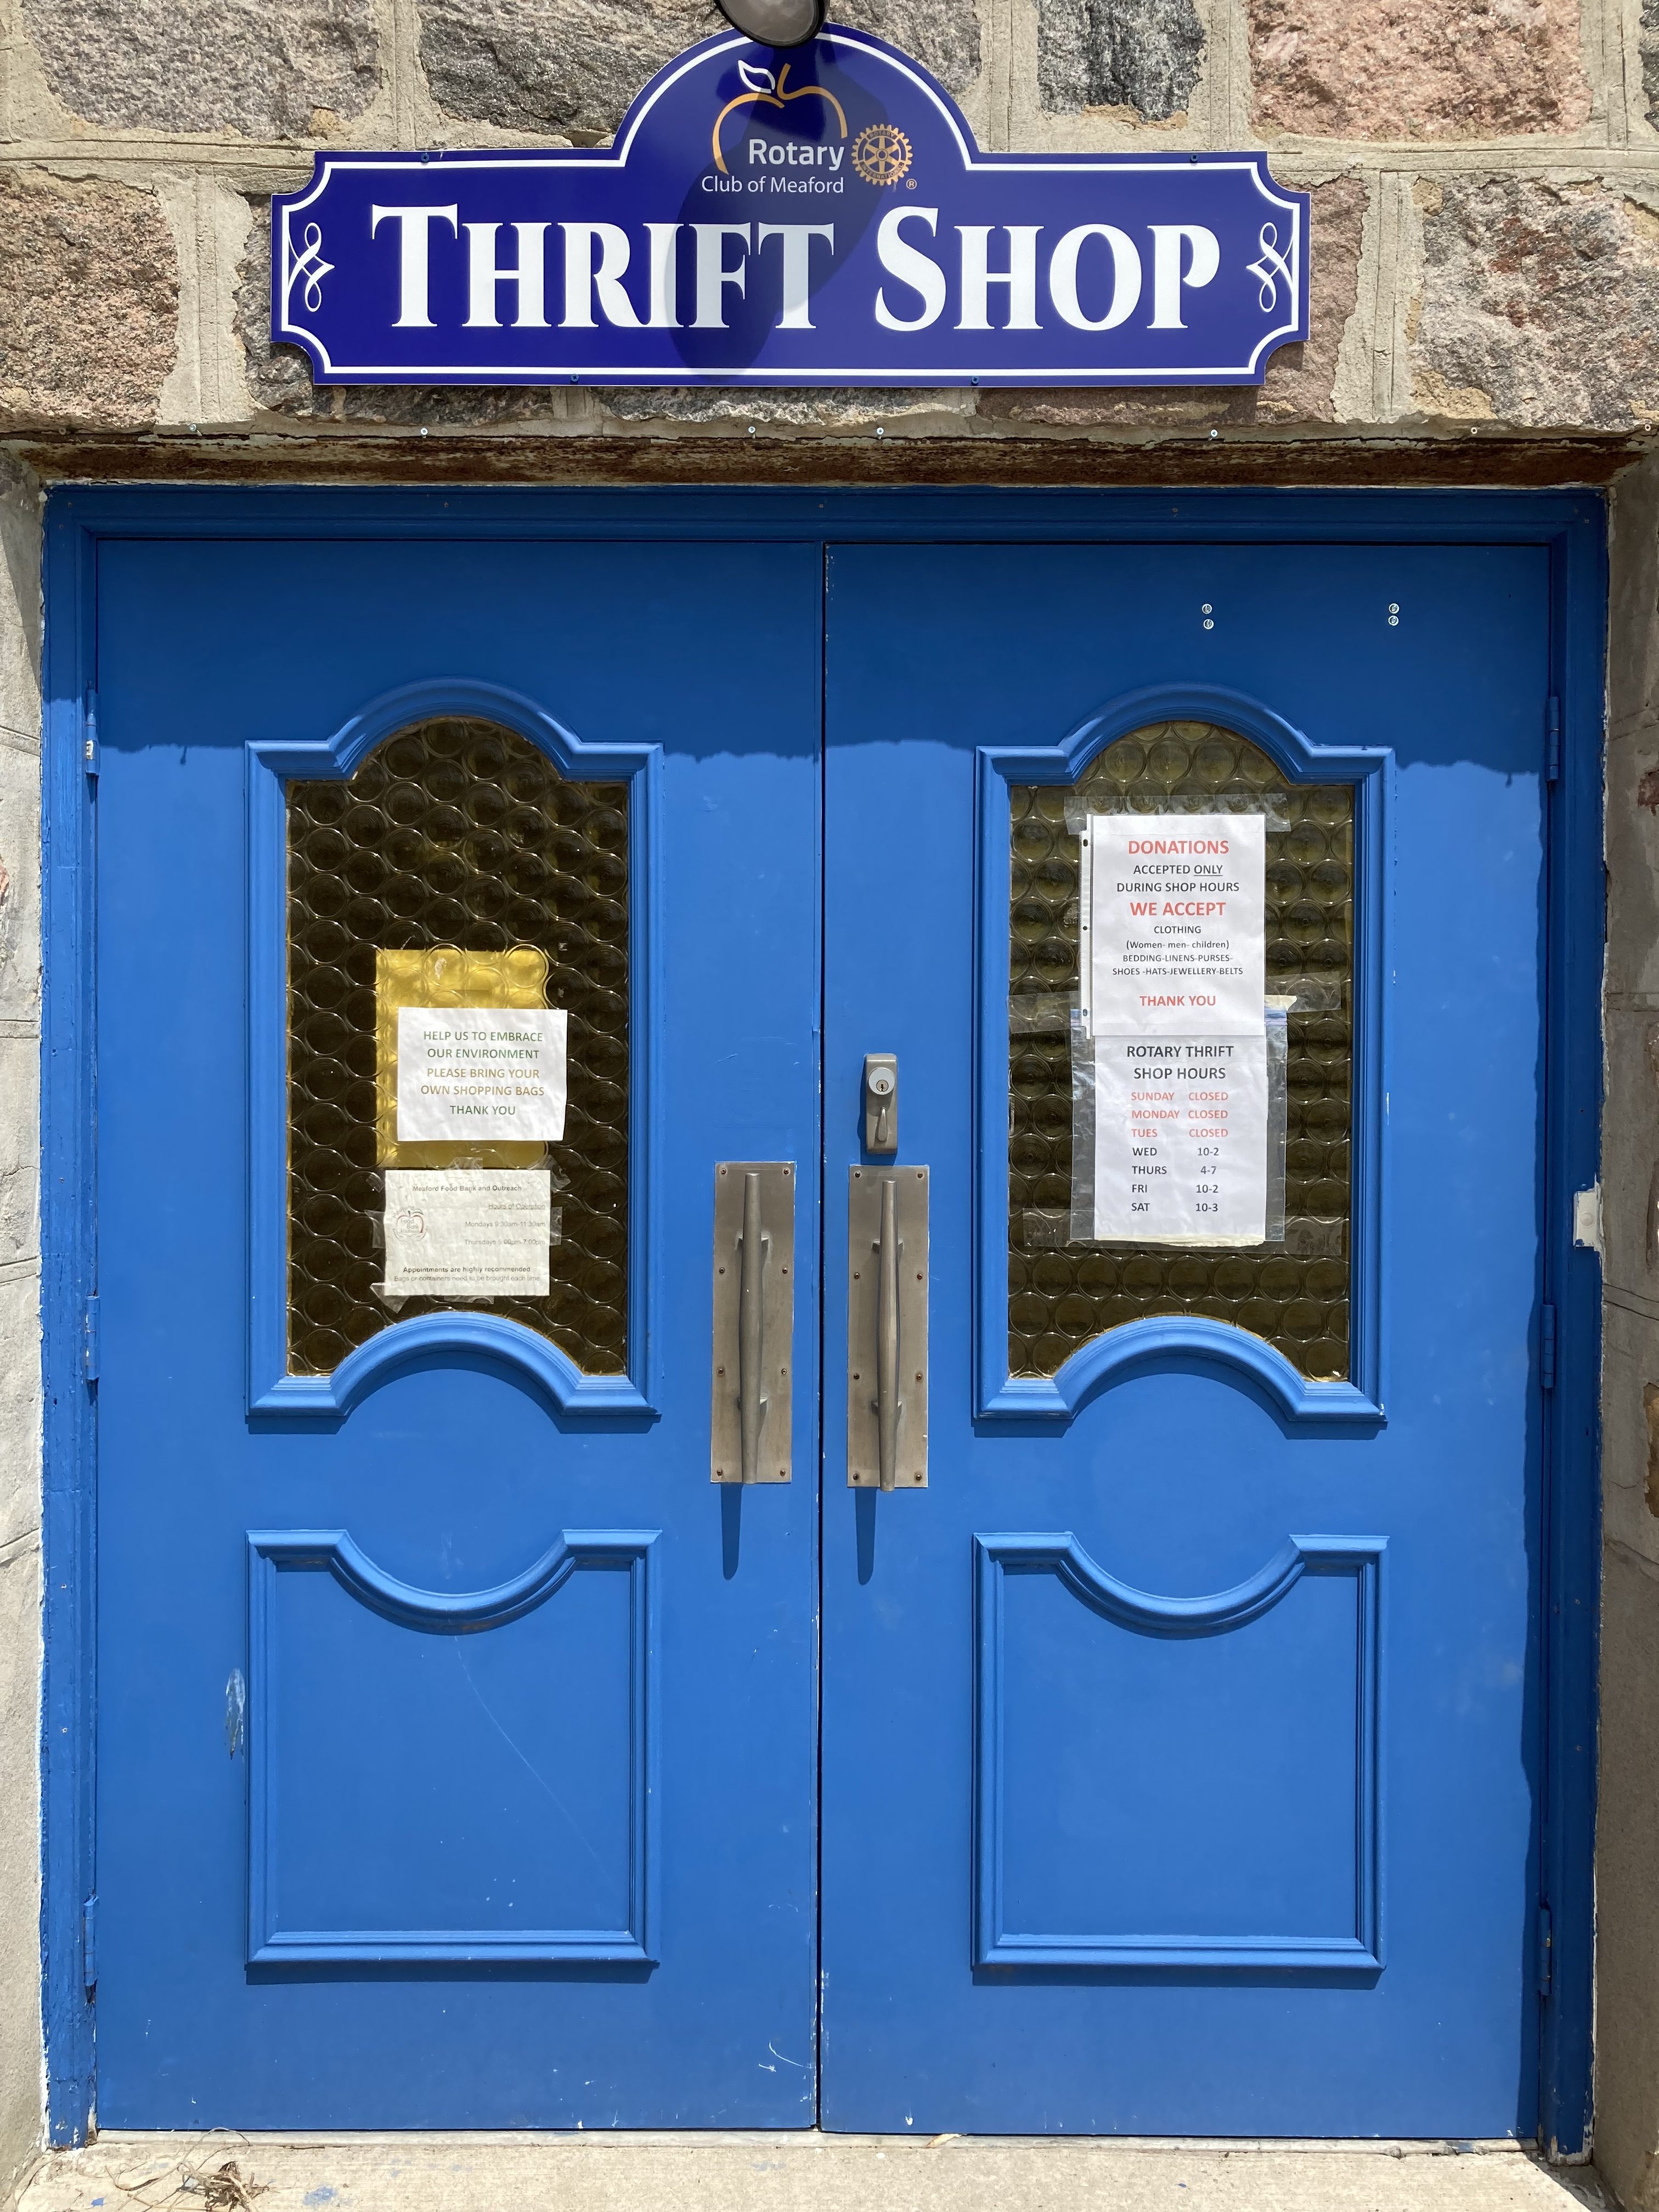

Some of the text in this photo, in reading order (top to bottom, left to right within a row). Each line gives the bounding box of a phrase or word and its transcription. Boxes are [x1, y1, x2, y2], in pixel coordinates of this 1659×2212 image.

[869, 130, 895, 138] ROTARY
[749, 139, 845, 171] Rotary
[702, 176, 844, 193] Club of Meaford
[371, 204, 1221, 332] THRIFT SHOP
[1128, 840, 1229, 854] DONATIONS
[1133, 865, 1223, 874] ACCEPTED ONLY
[1117, 882, 1239, 892] DURING SHOP HOURS
[1130, 902, 1226, 916] WE ACCEPT
[1154, 926, 1201, 934] CLOTHING
[1126, 940, 1166, 949] (Women-
[1192, 940, 1229, 950] children)
[1139, 995, 1216, 1006] THANK YOU
[424, 1031, 543, 1042] HELP US TO EMBRACE
[427, 1048, 539, 1059] OUR ENVIRONMENT
[1127, 1046, 1234, 1057] ROTARY THRIFT
[427, 1068, 539, 1079] PLEASE BRING YOUR
[1133, 1068, 1226, 1079] SHOP HOURS
[421, 1085, 544, 1096] OWN SHOPPING BAGS
[1131, 1092, 1228, 1101] SUNDAY CLOSED
[450, 1105, 516, 1115] THANK YOU
[1131, 1110, 1228, 1119] MONDAY CLOSED
[1131, 1128, 1228, 1137] TUES CLOSED
[1132, 1147, 1220, 1156] WED 10-2
[1132, 1166, 1217, 1174] THURS 4-7
[1132, 1184, 1219, 1193] FRI 10-2
[1131, 1203, 1218, 1212] SAT 10-3
